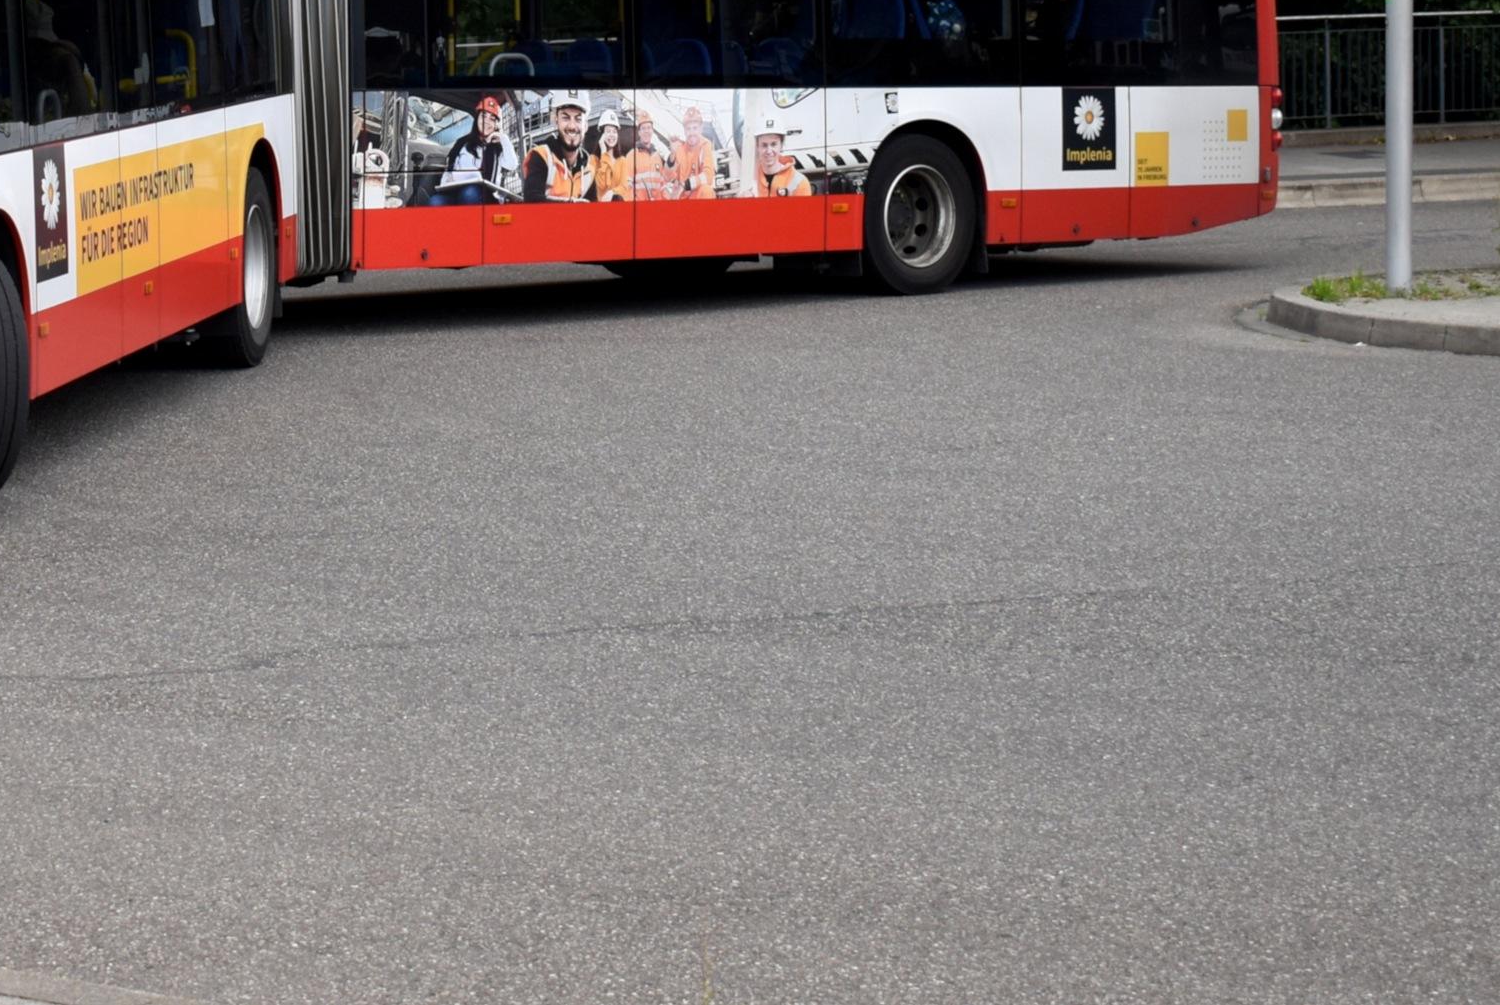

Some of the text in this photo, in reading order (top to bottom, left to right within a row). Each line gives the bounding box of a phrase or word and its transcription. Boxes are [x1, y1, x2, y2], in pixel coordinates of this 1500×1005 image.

[1066, 146, 1113, 165] Implenia
[79, 162, 195, 221] WIR BAUEN INFRASTRUKTUR
[38, 239, 67, 269] Implenia
[81, 216, 149, 265] FÜR DIE REGION
